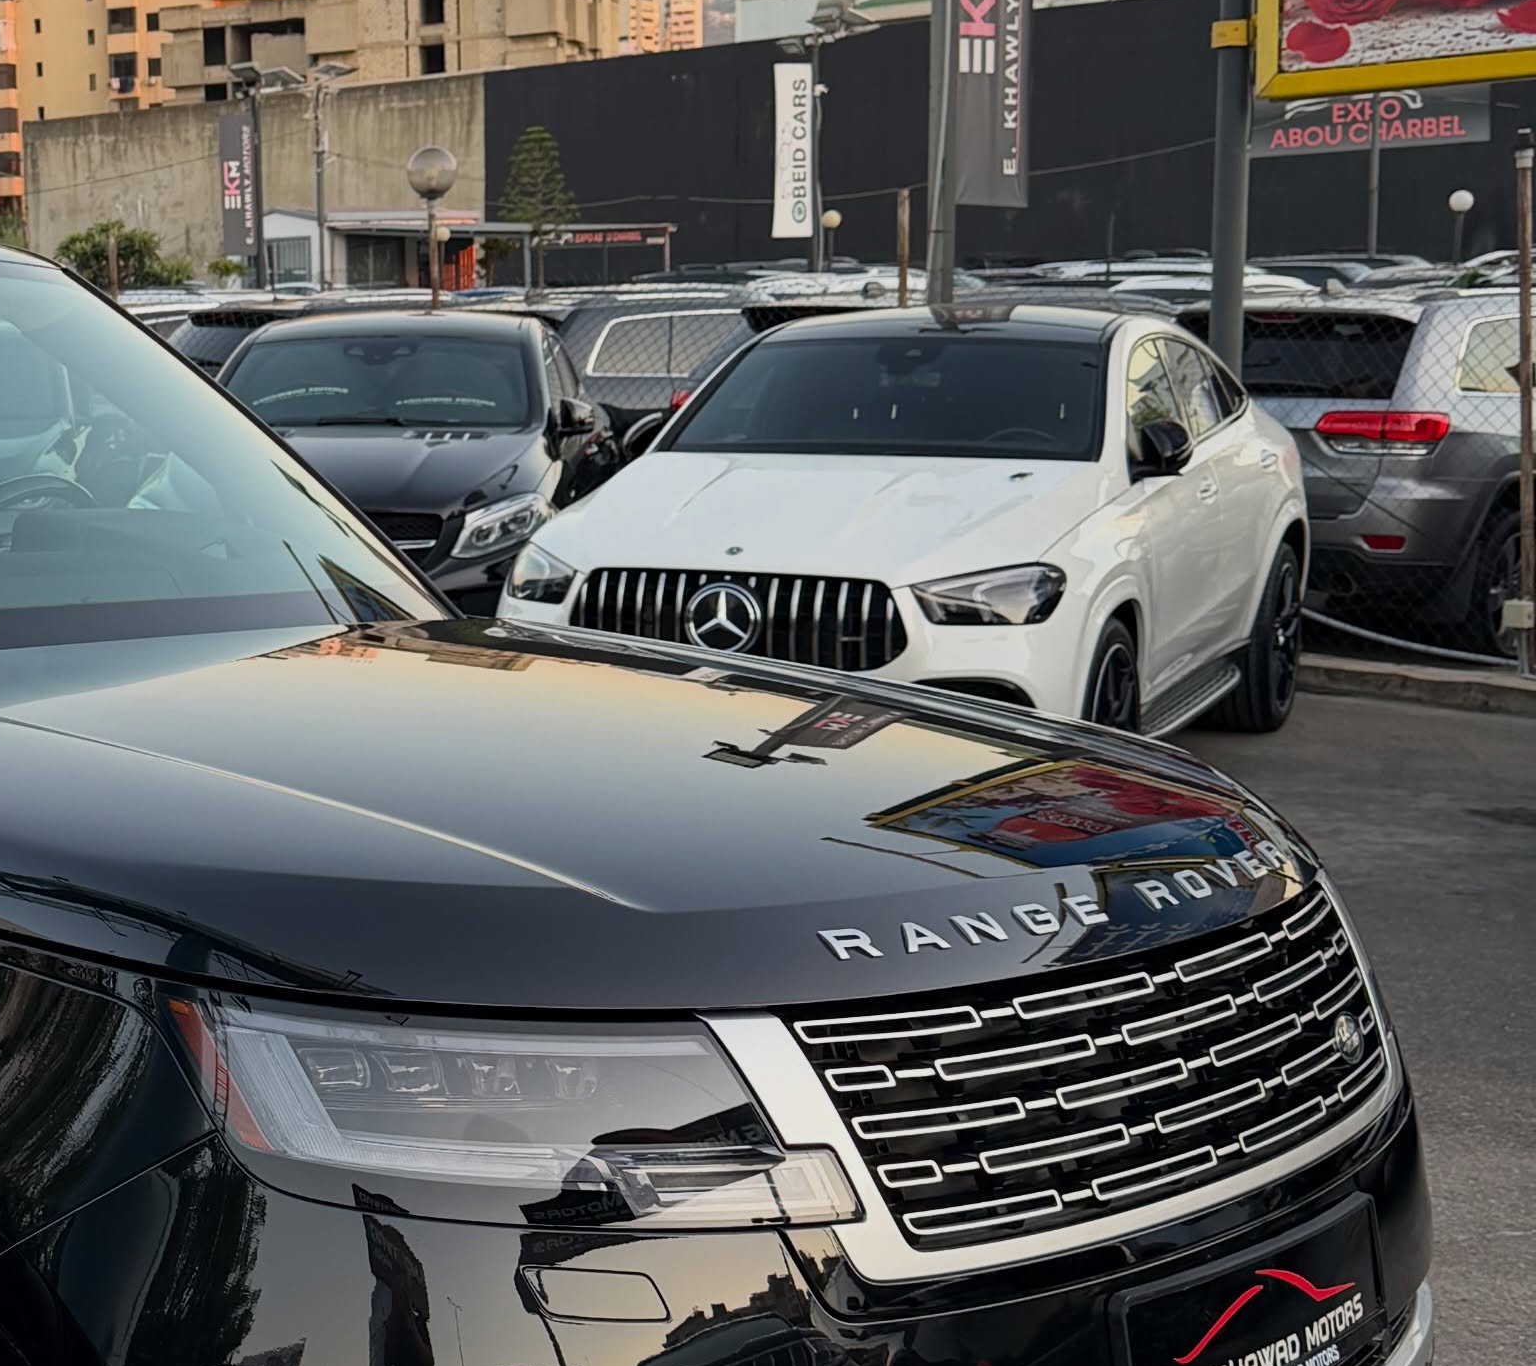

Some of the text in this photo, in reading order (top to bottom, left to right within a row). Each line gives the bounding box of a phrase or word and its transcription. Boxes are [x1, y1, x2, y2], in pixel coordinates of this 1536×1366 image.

[792, 79, 807, 140] CARS
[1003, 147, 1017, 175] E.
[1270, 125, 1343, 149] ABOU
[223, 160, 241, 209] EKM
[816, 838, 1288, 961] RANGE ROVER
[1304, 1292, 1364, 1352] MOTORS
